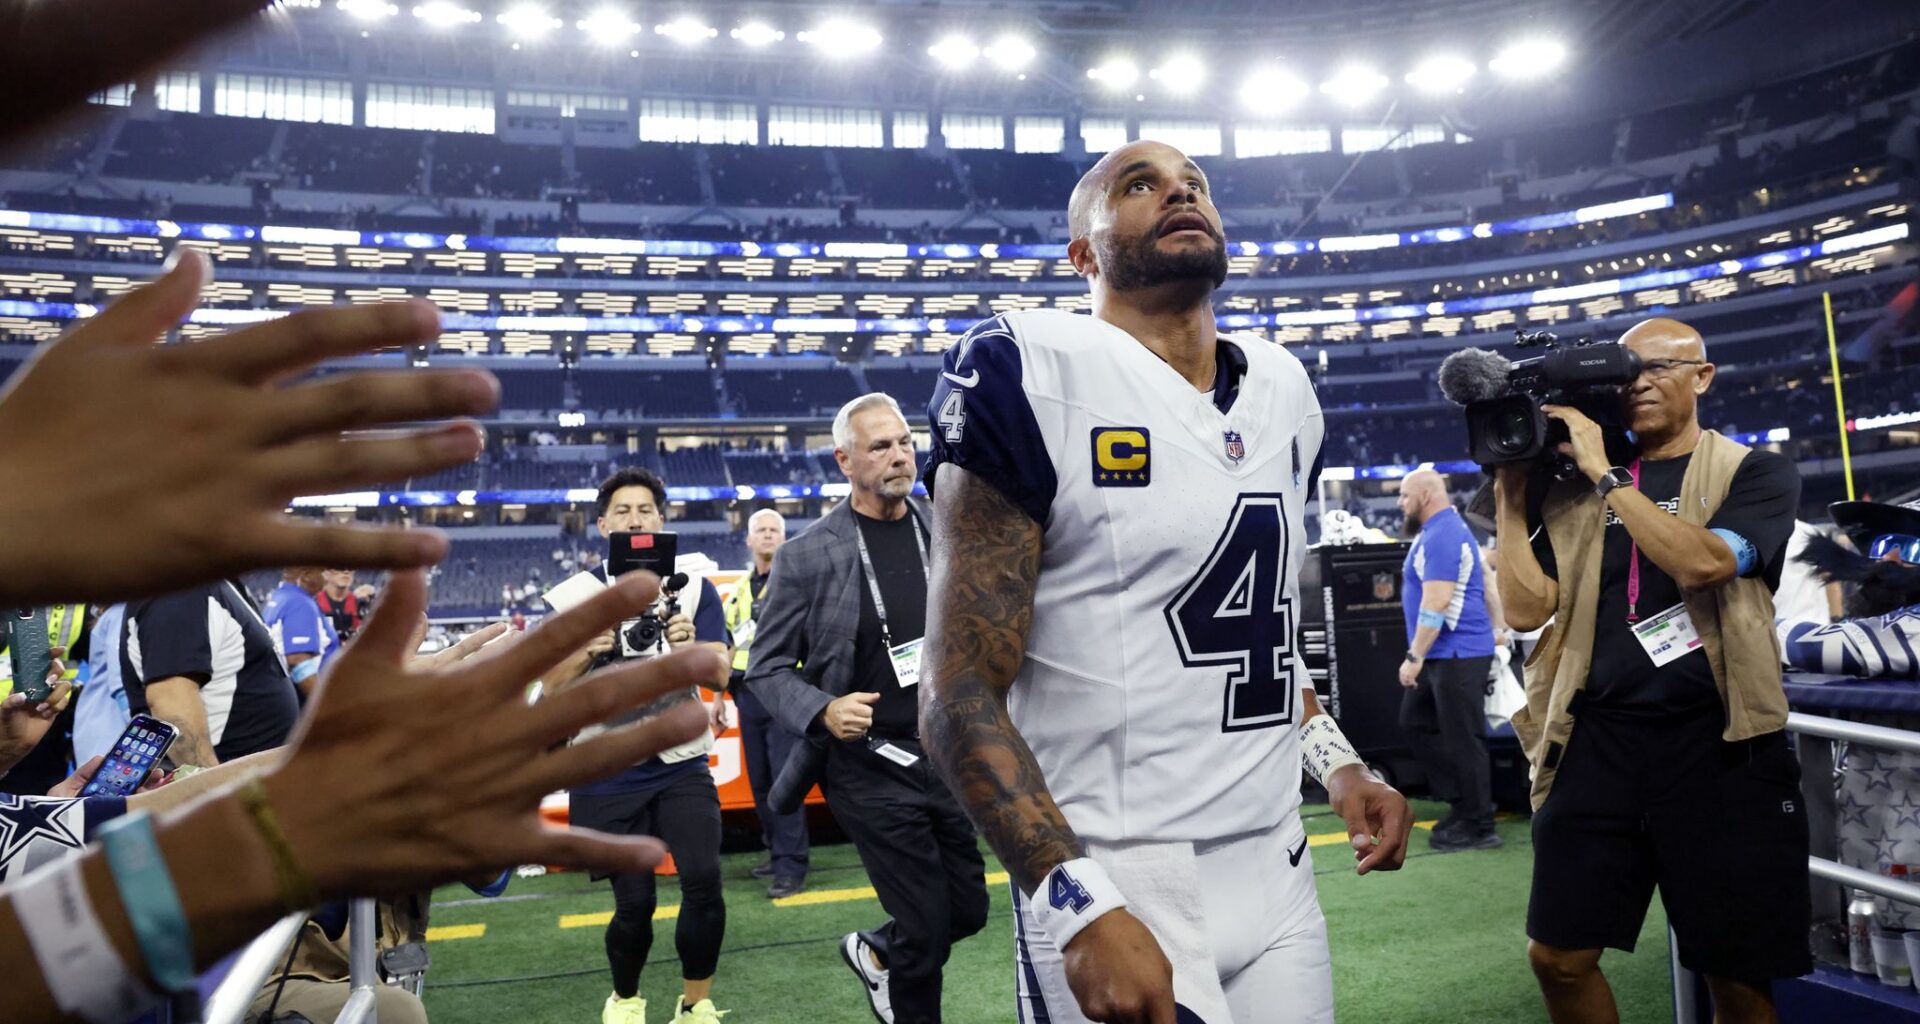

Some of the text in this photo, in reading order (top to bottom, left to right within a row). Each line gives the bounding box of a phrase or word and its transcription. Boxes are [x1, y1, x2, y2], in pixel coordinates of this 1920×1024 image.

[938, 388, 966, 443] 4
[1096, 431, 1147, 470] C
[1163, 492, 1294, 733] 4
[1048, 864, 1095, 916] 4
